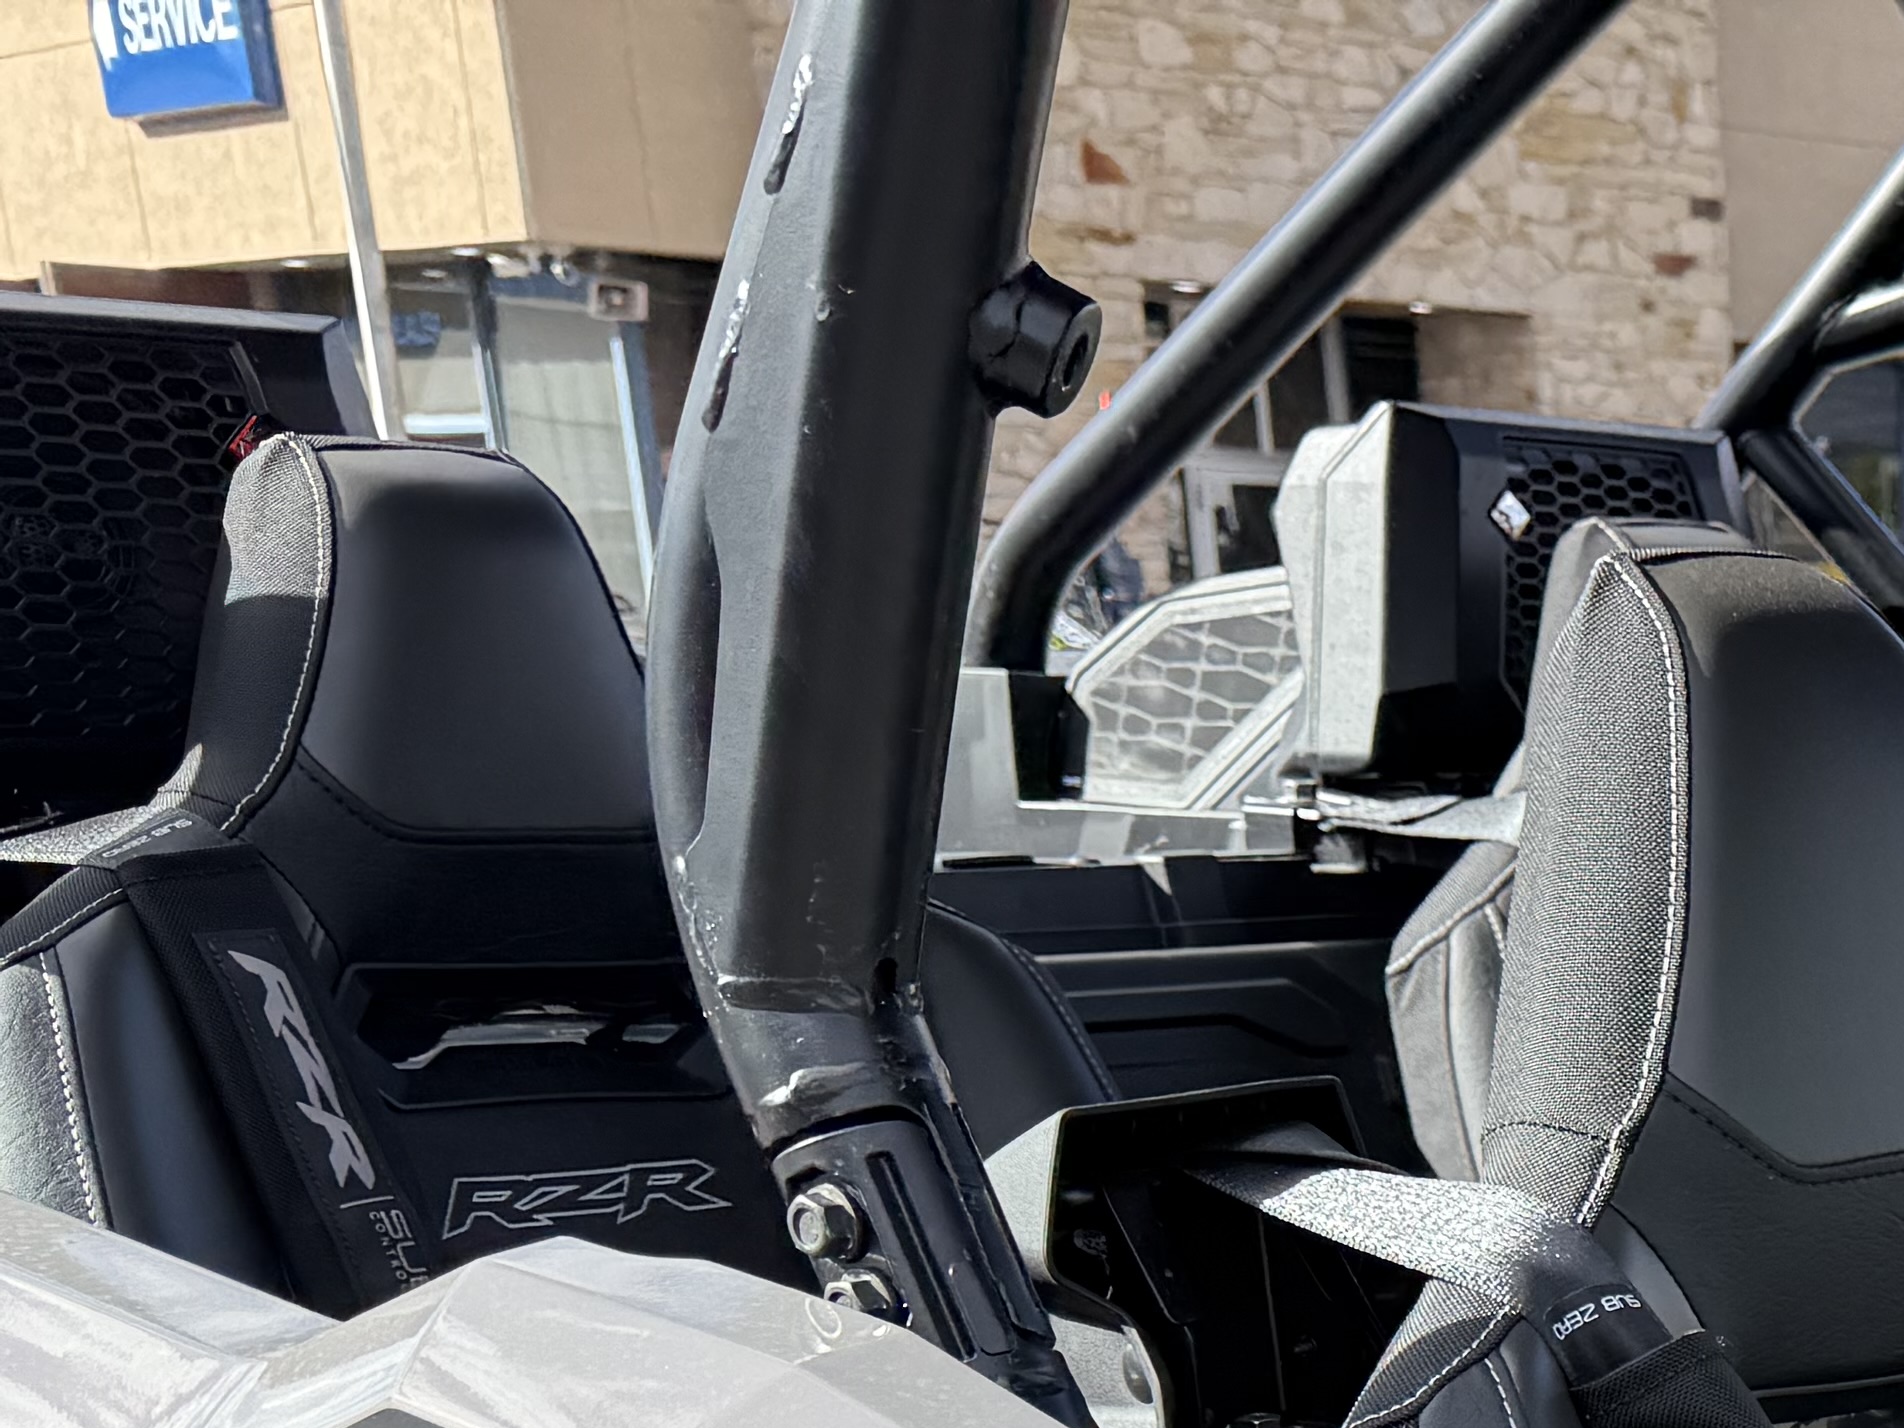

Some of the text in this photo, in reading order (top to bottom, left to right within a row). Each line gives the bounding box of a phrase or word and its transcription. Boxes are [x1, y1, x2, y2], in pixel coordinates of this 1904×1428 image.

[117, 0, 240, 55] SERVICE
[228, 949, 375, 1191] RZR
[441, 1157, 734, 1241] RZR
[1551, 1293, 1643, 1342] SUB ZERO
